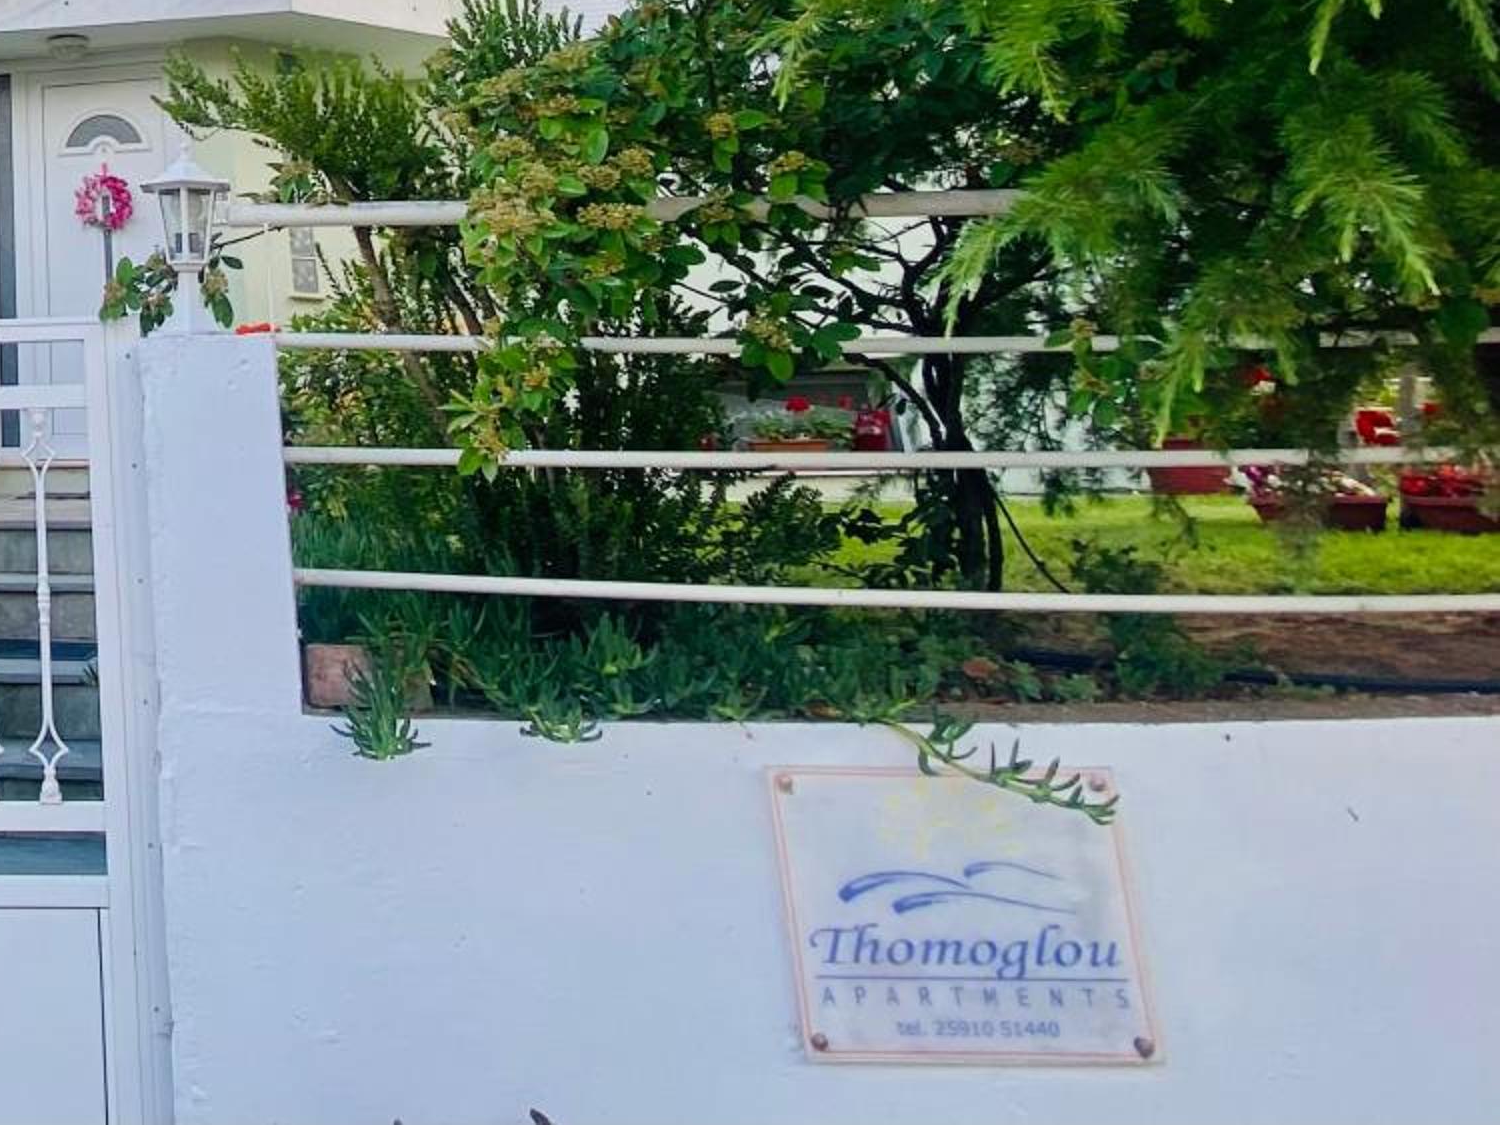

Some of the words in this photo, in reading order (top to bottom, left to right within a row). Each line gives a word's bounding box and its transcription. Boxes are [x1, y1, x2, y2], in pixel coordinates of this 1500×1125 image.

[809, 923, 1121, 980] Thomoglou
[821, 985, 1130, 1010] APARTMENTS
[934, 1020, 995, 1038] 25910
[1000, 1020, 1061, 1039] 51440
